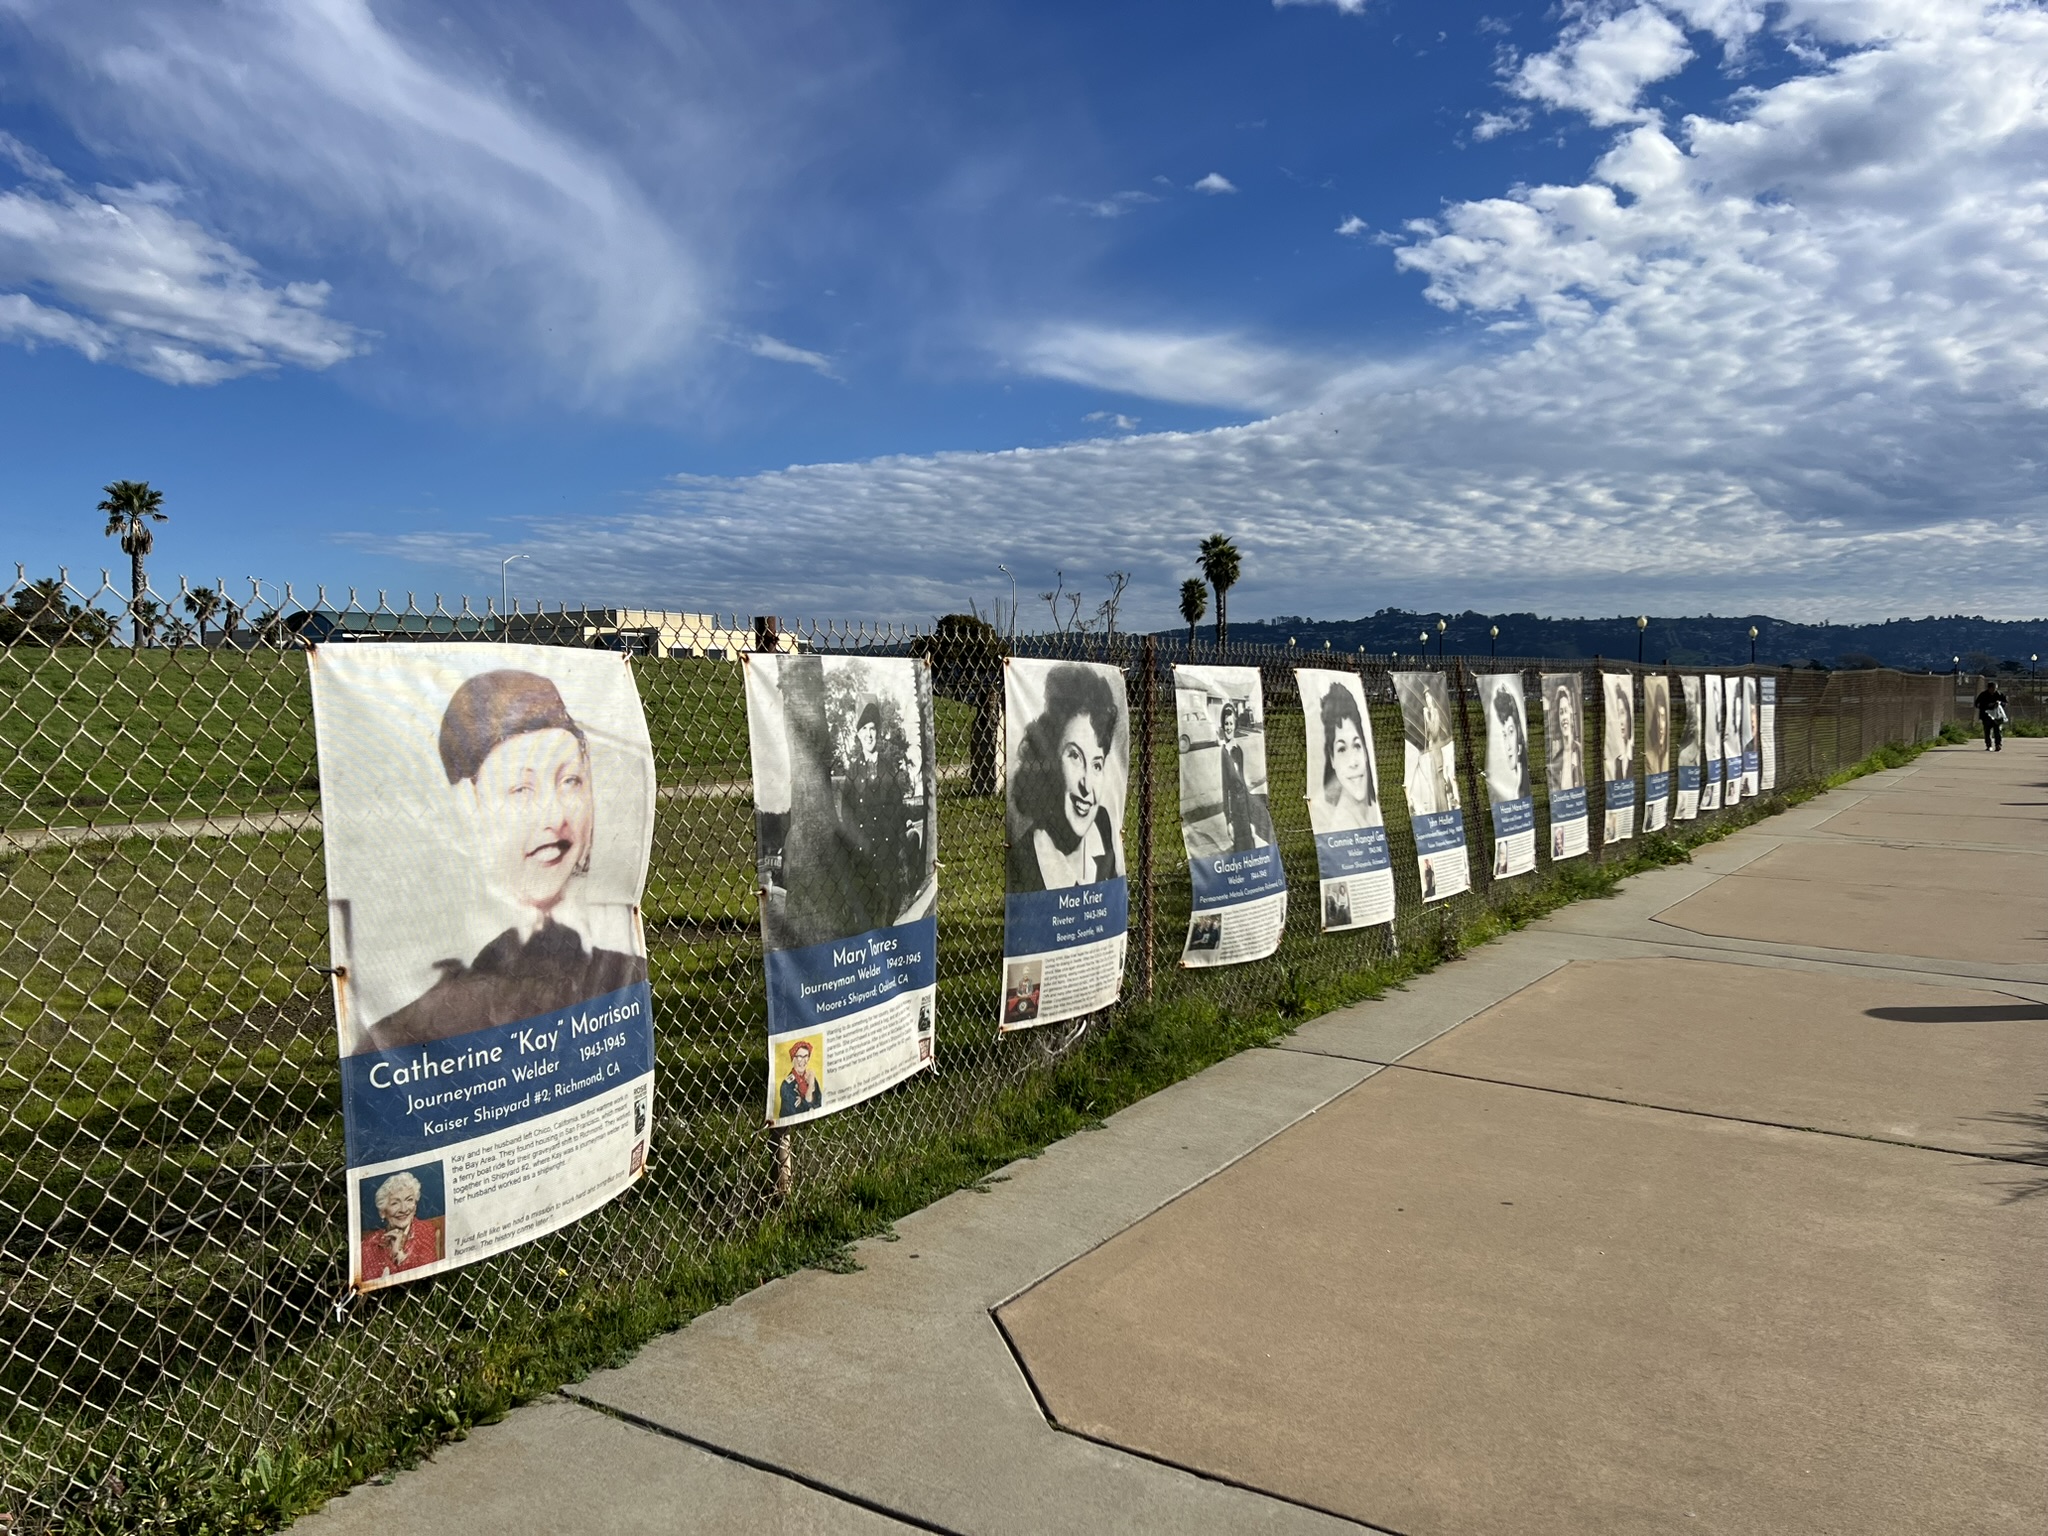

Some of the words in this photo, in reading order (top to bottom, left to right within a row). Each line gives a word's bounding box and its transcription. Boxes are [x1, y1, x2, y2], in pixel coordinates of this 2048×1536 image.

[1327, 836, 1354, 848] Connie
[1354, 830, 1375, 845] Rangel
[1213, 857, 1242, 874] Gladys
[1227, 874, 1245, 885] Welder
[1052, 915, 1075, 927] Riveter
[1083, 907, 1108, 921] 1943-1945
[1059, 893, 1080, 910] Mae
[1082, 890, 1103, 905] Krier
[1199, 893, 1229, 904] Permanente
[833, 946, 867, 968] Mary
[868, 938, 898, 957] Torres
[800, 974, 856, 999] Journeyman
[857, 963, 881, 980] Welder
[886, 951, 922, 970] 1942-1945
[816, 995, 847, 1013] Moore's
[897, 974, 909, 985] CA
[369, 1046, 503, 1089] Catherine
[571, 1001, 640, 1039] Morrison
[406, 1077, 507, 1115] Journeyman
[511, 1058, 560, 1083] Welder
[579, 1032, 626, 1062] 1943-1945
[423, 1116, 469, 1136] Kaiser
[473, 1092, 530, 1123] Shipyard
[534, 1089, 552, 1105] #2;
[554, 1066, 605, 1097] Richmond,
[606, 1061, 621, 1077] CA
[451, 1153, 466, 1163] Kay
[467, 1148, 481, 1158] and
[481, 1145, 493, 1154] her
[494, 1135, 522, 1150] husband
[523, 1131, 533, 1140] left
[533, 1126, 553, 1137] Chico,
[613, 1095, 624, 1105] work
[452, 1165, 463, 1174] the
[465, 1160, 479, 1171] Bay
[479, 1155, 497, 1166] Area.
[499, 1148, 516, 1159] They
[516, 1142, 534, 1153] found
[535, 1132, 558, 1148] housing
[565, 1125, 575, 1134] San
[601, 1109, 614, 1119] which
[453, 1178, 482, 1195] together
[483, 1176, 490, 1184] in
[491, 1166, 520, 1182] Shipyard
[532, 1155, 551, 1168] where
[551, 1151, 562, 1161] Kay
[563, 1147, 574, 1156] was
[578, 1132, 607, 1150] journeyman
[459, 1172, 476, 1183] ferry
[476, 1167, 492, 1177] boat
[492, 1160, 506, 1172] ride
[506, 1158, 516, 1166] for
[516, 1152, 531, 1163] their
[531, 1141, 560, 1160] graveyard
[561, 1137, 572, 1146] shift
[604, 1117, 616, 1128] They
[453, 1195, 466, 1205] her
[467, 1186, 497, 1200] husband
[497, 1176, 521, 1190] worked
[522, 1173, 531, 1182] as
[460, 1232, 476, 1247] just
[476, 1228, 488, 1240] felt
[489, 1224, 501, 1236] like
[502, 1222, 512, 1231] we
[512, 1217, 525, 1228] had
[525, 1214, 530, 1222] a
[530, 1206, 555, 1219] mission
[562, 1196, 575, 1207] work
[575, 1190, 587, 1202] hard
[480, 1239, 494, 1248] The
[494, 1230, 516, 1245] history
[516, 1223, 535, 1235] came
